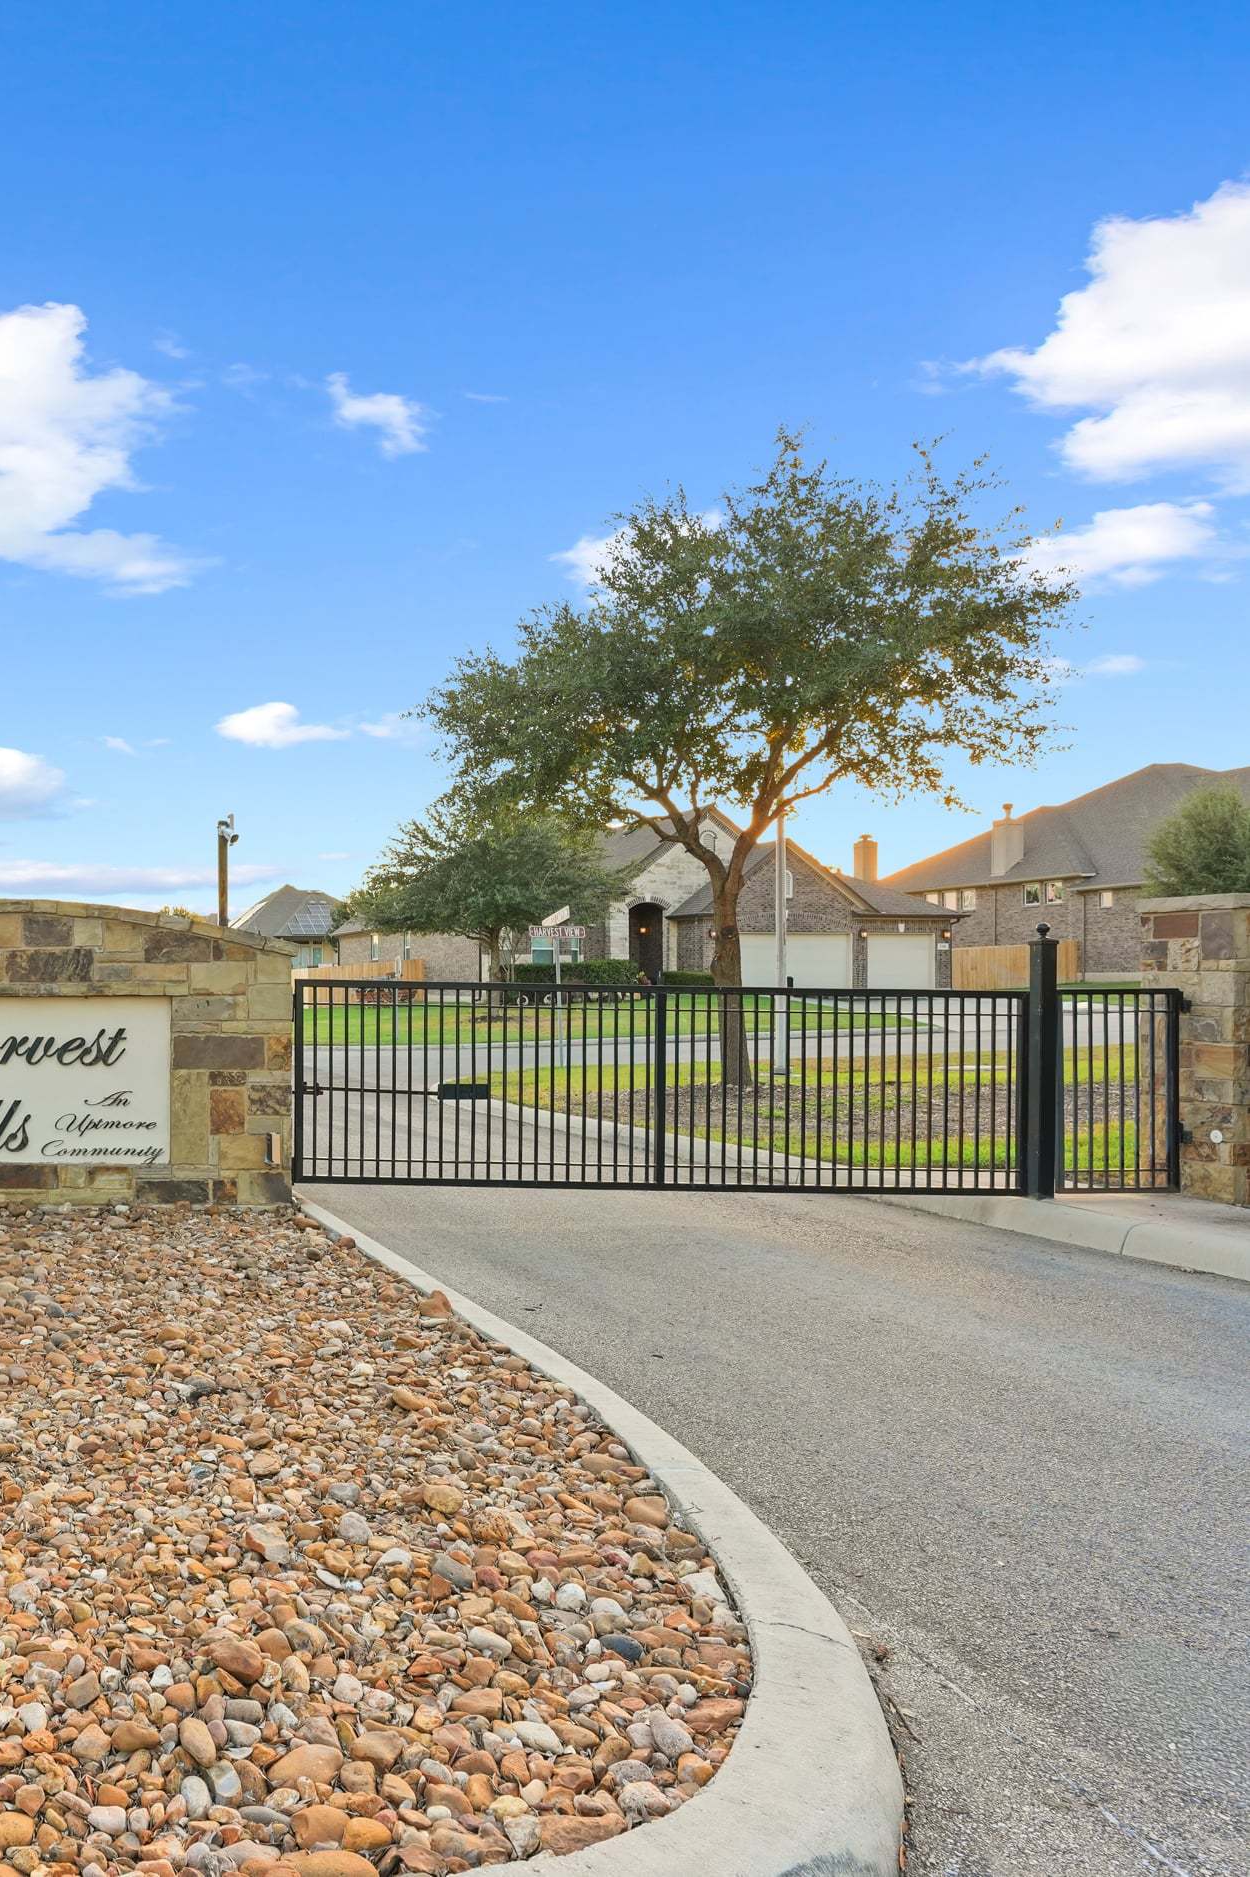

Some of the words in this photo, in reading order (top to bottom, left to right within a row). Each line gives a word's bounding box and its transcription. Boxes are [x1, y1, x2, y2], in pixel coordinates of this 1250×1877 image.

[533, 927, 562, 937] HARVEST
[564, 927, 580, 937] VIEW
[83, 1090, 133, 1107] An
[54, 1113, 158, 1137] Uptmore
[40, 1139, 165, 1165] Community
